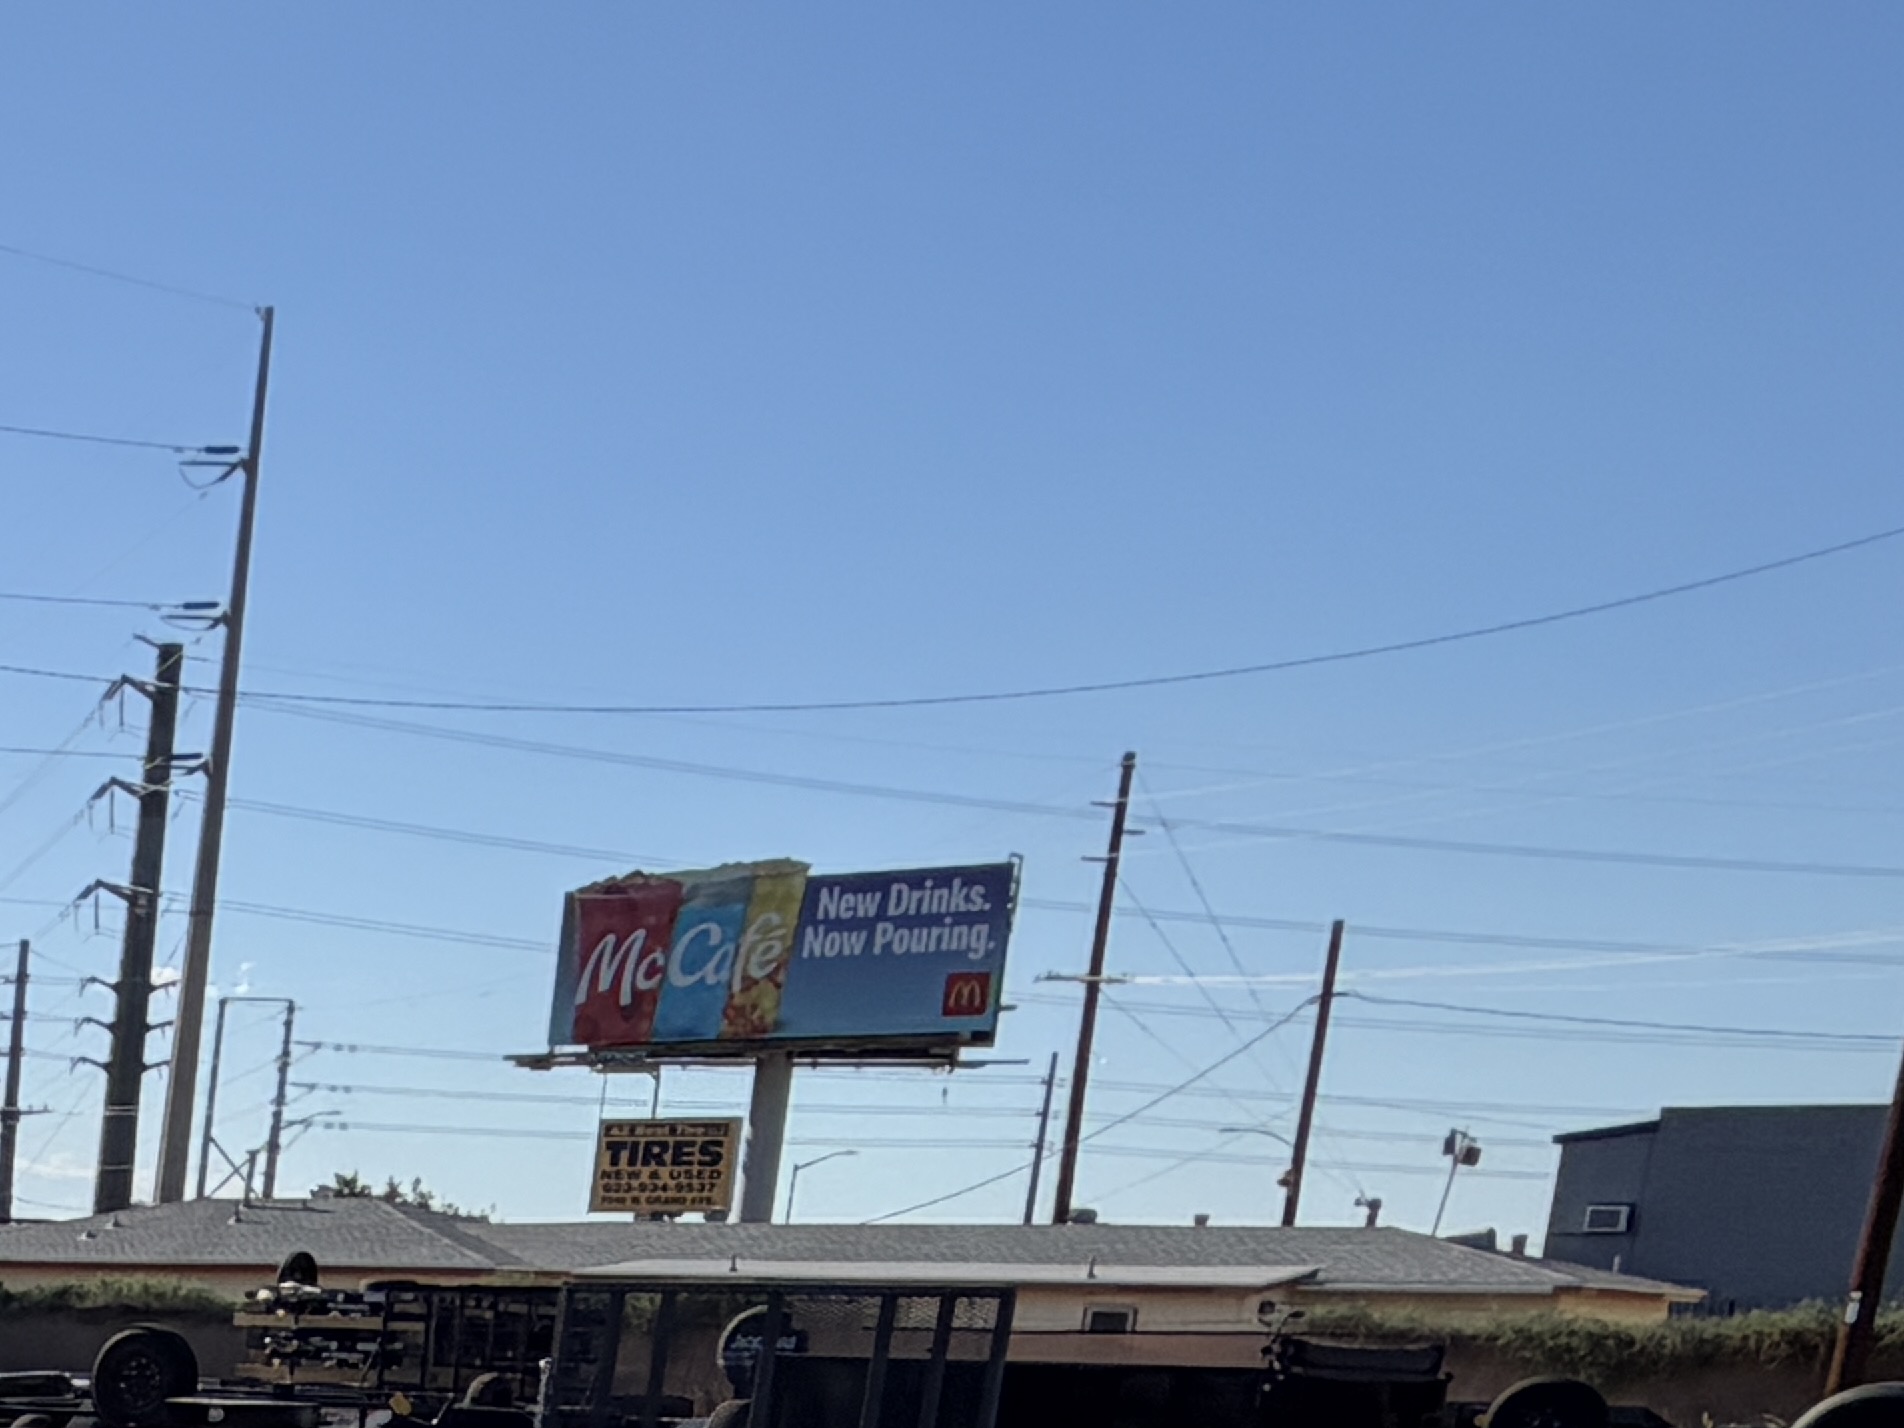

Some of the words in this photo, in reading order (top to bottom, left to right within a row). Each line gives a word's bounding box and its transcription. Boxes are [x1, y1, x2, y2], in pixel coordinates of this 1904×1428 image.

[816, 885, 882, 921] New
[887, 877, 992, 916] Drinks.
[575, 912, 789, 1006] McCafé
[801, 924, 870, 960] Now
[874, 917, 996, 961] Pouring.
[600, 1169, 641, 1180] NEW
[648, 1168, 660, 1180] &
[668, 1168, 722, 1180] USED
[605, 1140, 725, 1167] TIRES
